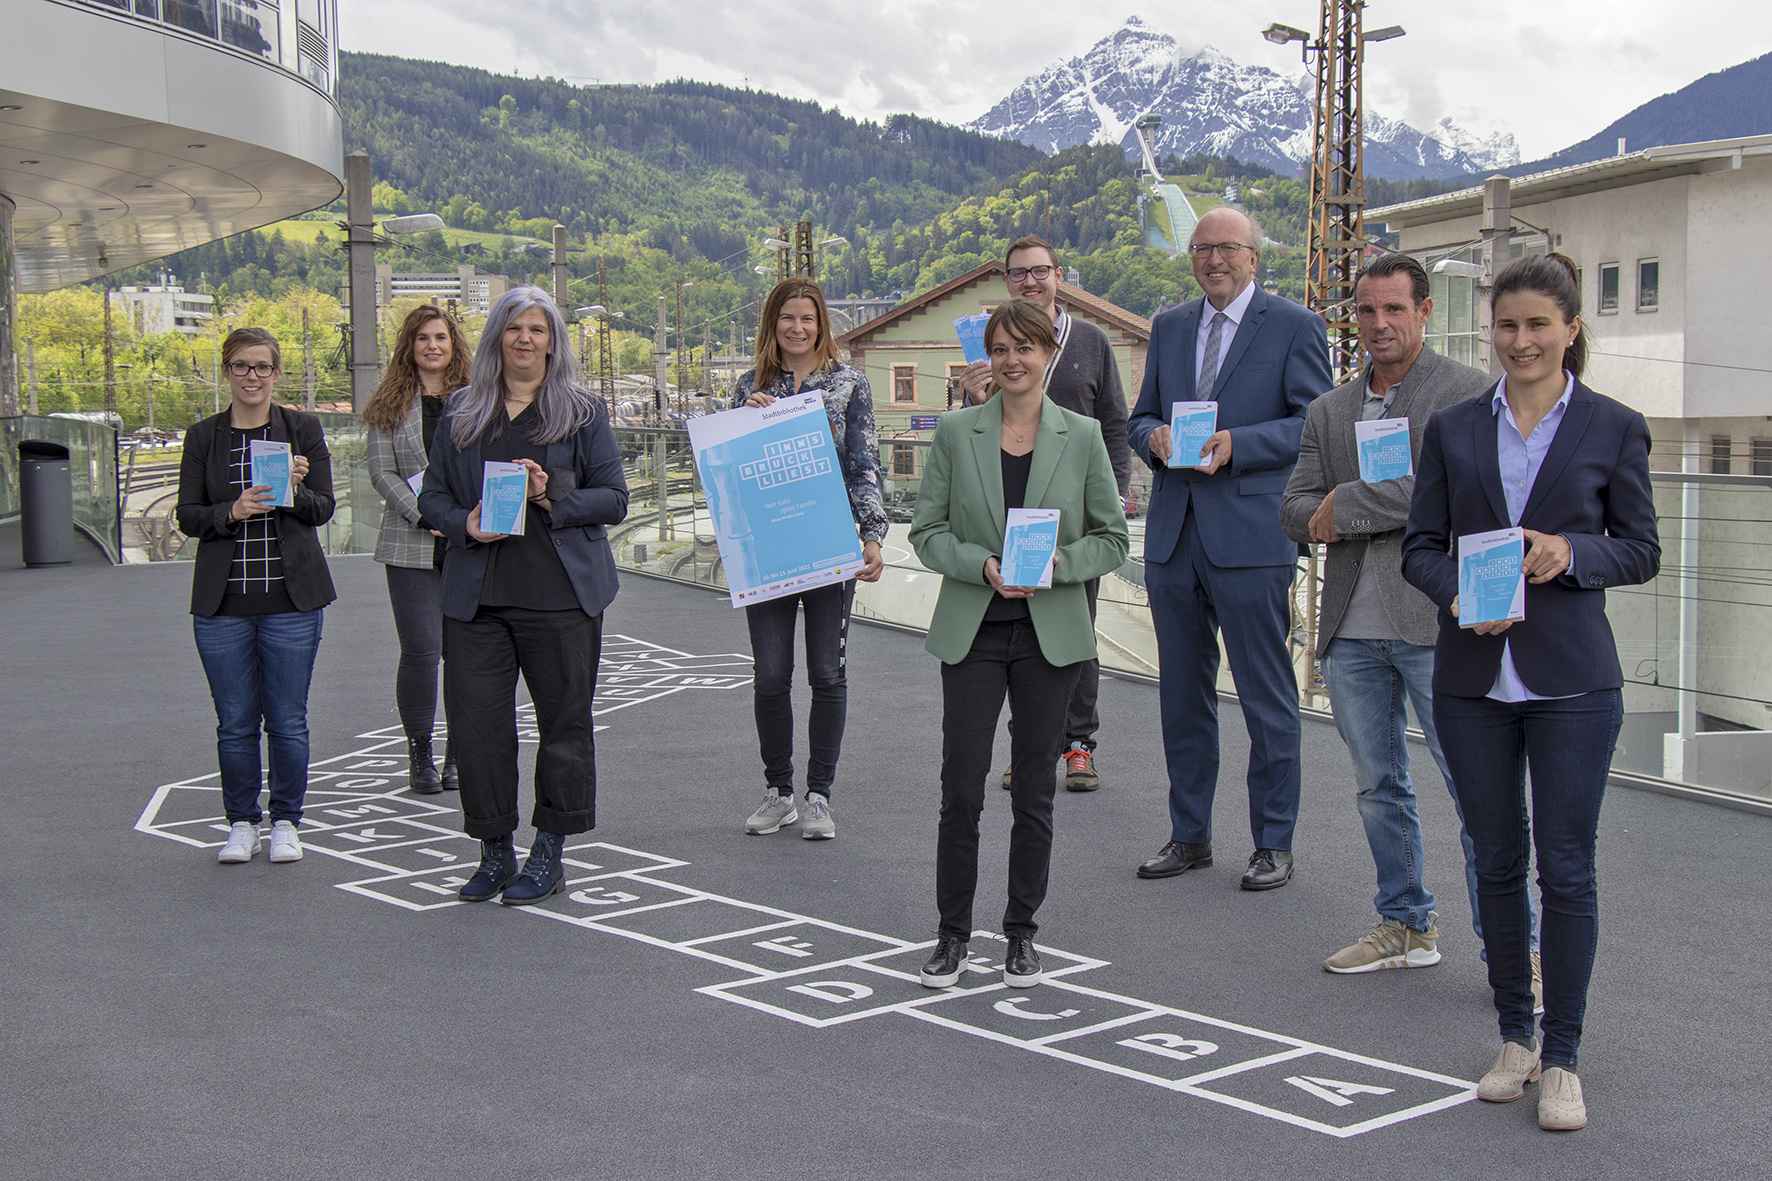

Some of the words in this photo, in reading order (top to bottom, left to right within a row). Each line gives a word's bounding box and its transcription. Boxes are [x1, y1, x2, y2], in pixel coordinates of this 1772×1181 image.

[761, 405, 807, 420] Stadtbibliothek
[770, 435, 820, 455] INNS
[744, 452, 809, 476] BRUCK
[763, 462, 826, 486] LIEST
[764, 502, 777, 510] Herr
[779, 505, 796, 514] spielt
[796, 500, 817, 510] Familie
[1481, 536, 1510, 545] Stadtbibliothek
[345, 760, 398, 769] P
[323, 804, 398, 818] M
[333, 828, 406, 843] K
[569, 887, 640, 905] G
[752, 936, 814, 957] F
[786, 981, 874, 1004] D
[993, 997, 1081, 1021] C
[1116, 1033, 1220, 1061] B
[1283, 1076, 1396, 1107] A
